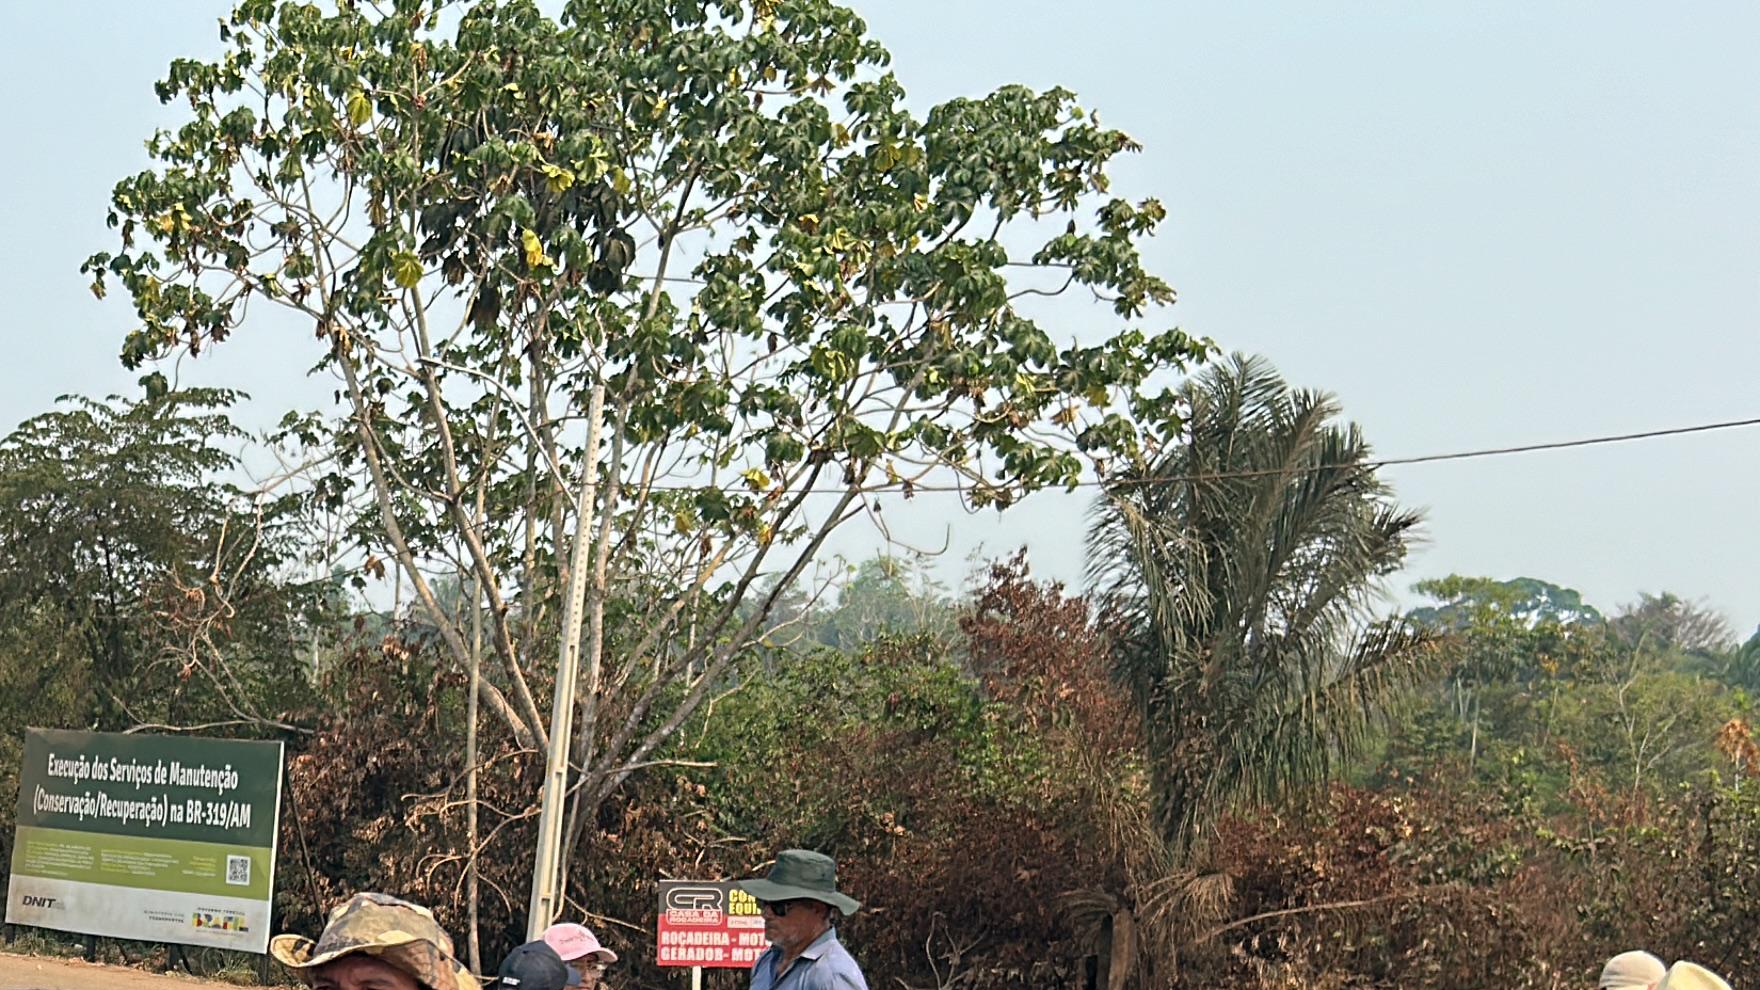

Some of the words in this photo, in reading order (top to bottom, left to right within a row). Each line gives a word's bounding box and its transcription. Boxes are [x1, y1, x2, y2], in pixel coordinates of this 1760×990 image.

[47, 753, 90, 784] Execução
[91, 755, 109, 779] dos
[110, 757, 153, 790] Serviços
[154, 759, 168, 784] de
[169, 761, 239, 796] Manutenção
[33, 784, 168, 827] (Conservação/Recuperação)
[170, 803, 183, 823] na
[186, 799, 251, 829] BR-319/AM
[21, 895, 57, 910] DNIT
